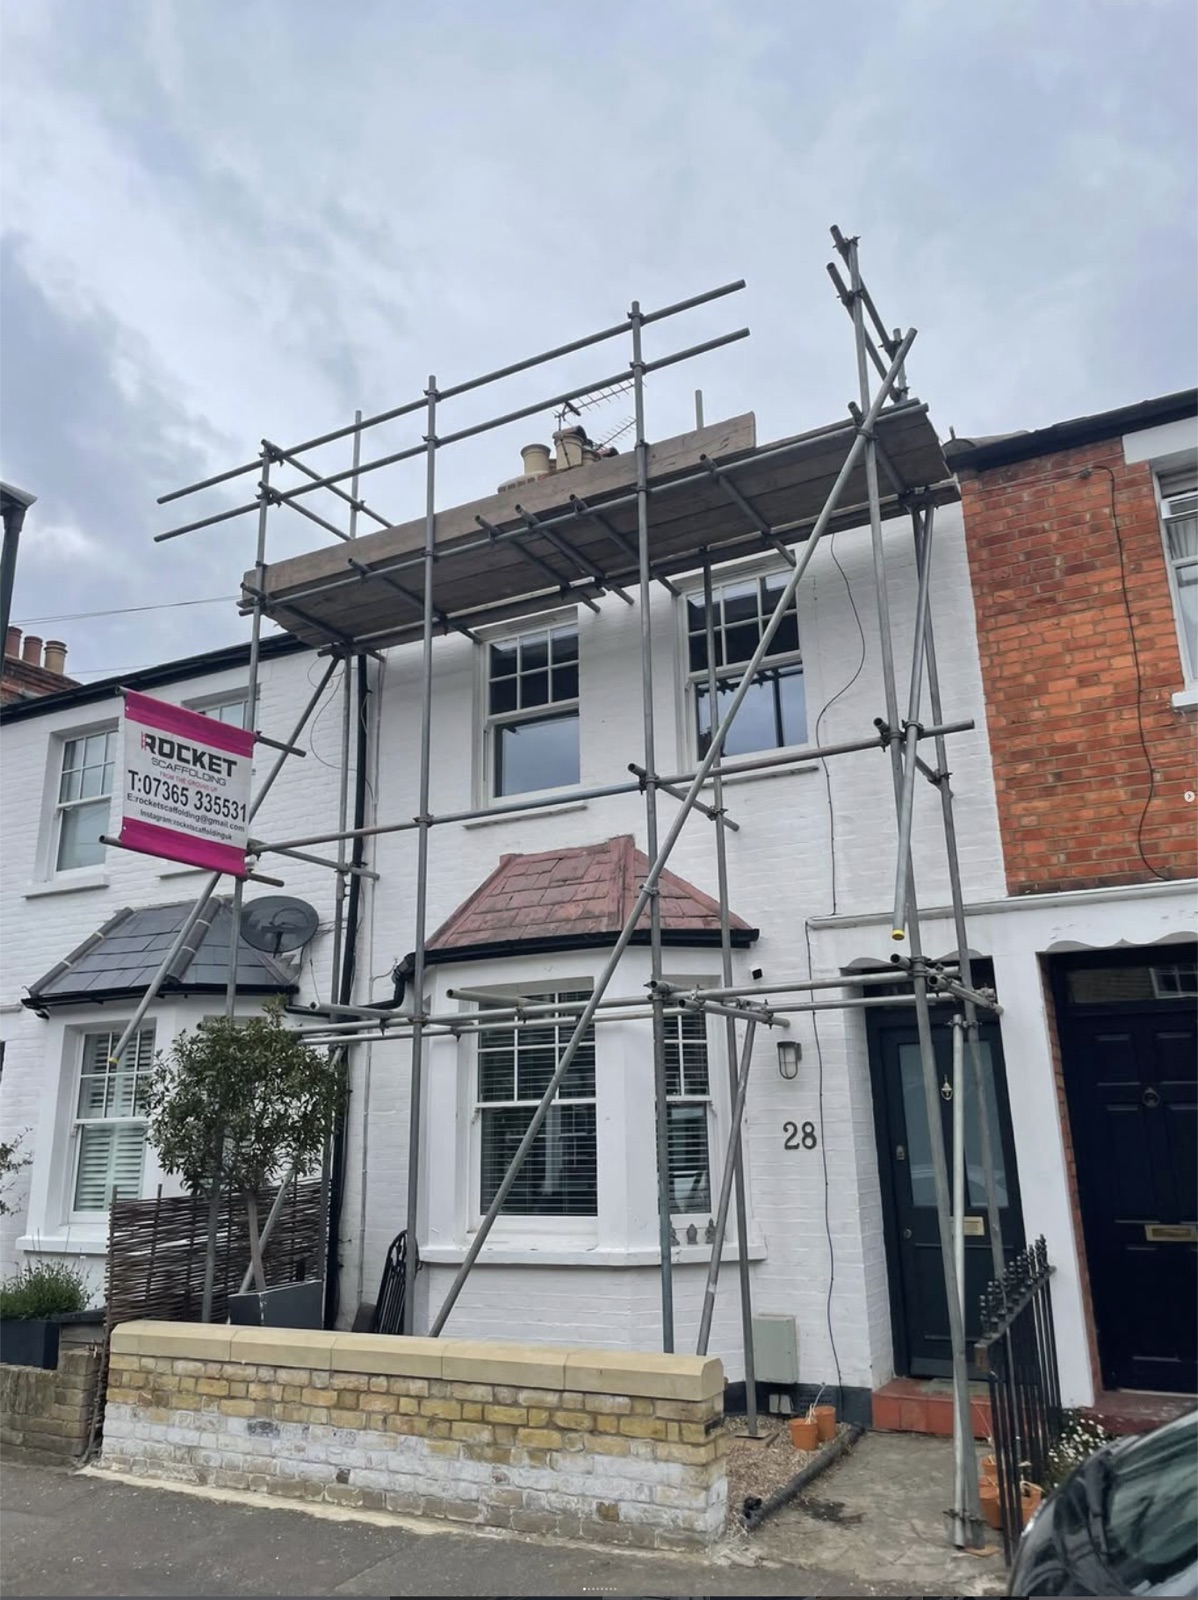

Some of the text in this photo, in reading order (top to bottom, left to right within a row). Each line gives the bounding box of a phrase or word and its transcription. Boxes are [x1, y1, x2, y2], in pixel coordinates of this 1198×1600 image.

[141, 732, 237, 777] ROCKET
[151, 757, 227, 786] SCAFFOLDING
[128, 769, 247, 822] T:07365 335531
[783, 1121, 817, 1150] 28
